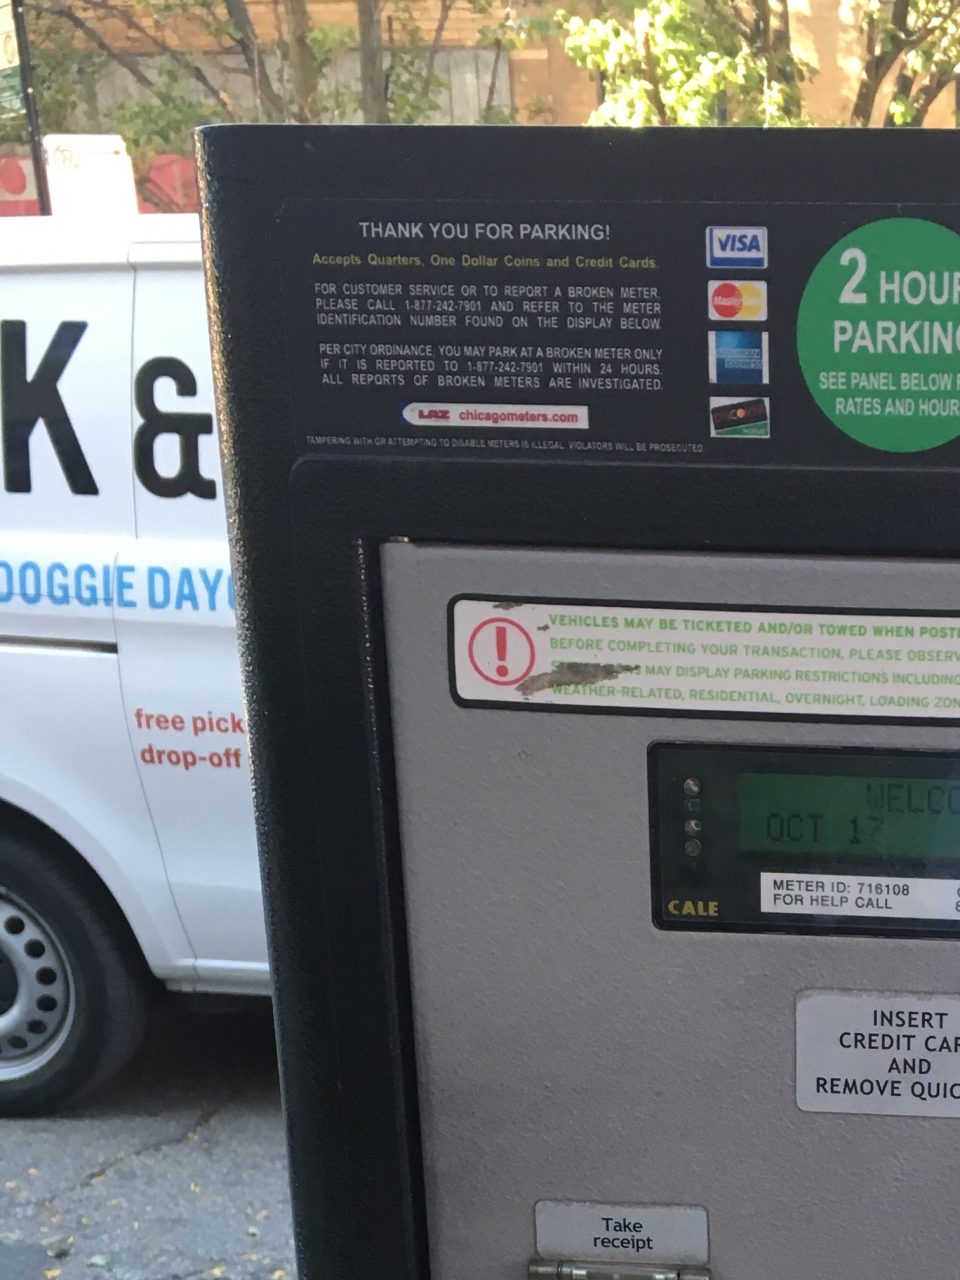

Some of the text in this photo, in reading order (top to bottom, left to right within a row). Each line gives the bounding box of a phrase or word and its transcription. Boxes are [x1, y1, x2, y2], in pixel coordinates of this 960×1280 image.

[359, 222, 610, 240] THANK YOU FOR PARKING!
[718, 234, 761, 252] VISA
[312, 253, 361, 266] Accepts
[431, 255, 455, 266] One
[462, 254, 497, 267] Dollar
[505, 256, 540, 268] Coins
[546, 256, 569, 268] and
[576, 256, 612, 269] Credit
[839, 247, 867, 304] 2
[316, 299, 661, 314] PLEASE CALL 1-877-242-7901 AND REFER TO THE METER
[819, 372, 846, 389] SEE
[851, 373, 896, 390] PANEL
[901, 373, 952, 390] BELOW
[0, 320, 216, 500] K &
[836, 398, 881, 415] RATES
[885, 399, 913, 415] AND
[459, 409, 578, 426] chicagometers.com
[549, 614, 619, 628] VEHICLES
[624, 617, 654, 629] MAY
[660, 618, 677, 630] BE
[683, 619, 752, 633] TICKETED
[758, 621, 812, 635] AND/OR
[819, 623, 867, 637] TOWED
[872, 625, 914, 638] WHEN
[135, 708, 245, 736] free pick
[140, 743, 241, 770] drop-off
[767, 814, 824, 843] OCT
[773, 880, 910, 896] METER ID: 716108
[668, 900, 719, 917] CALE
[773, 894, 893, 910] FOR HELP CALL
[873, 1010, 948, 1029] INSERT
[839, 1032, 916, 1052] CREDIT
[888, 1057, 931, 1075] AND
[816, 1078, 902, 1097] REMOVE
[601, 1217, 643, 1232] Take
[594, 1235, 653, 1252] receipt
